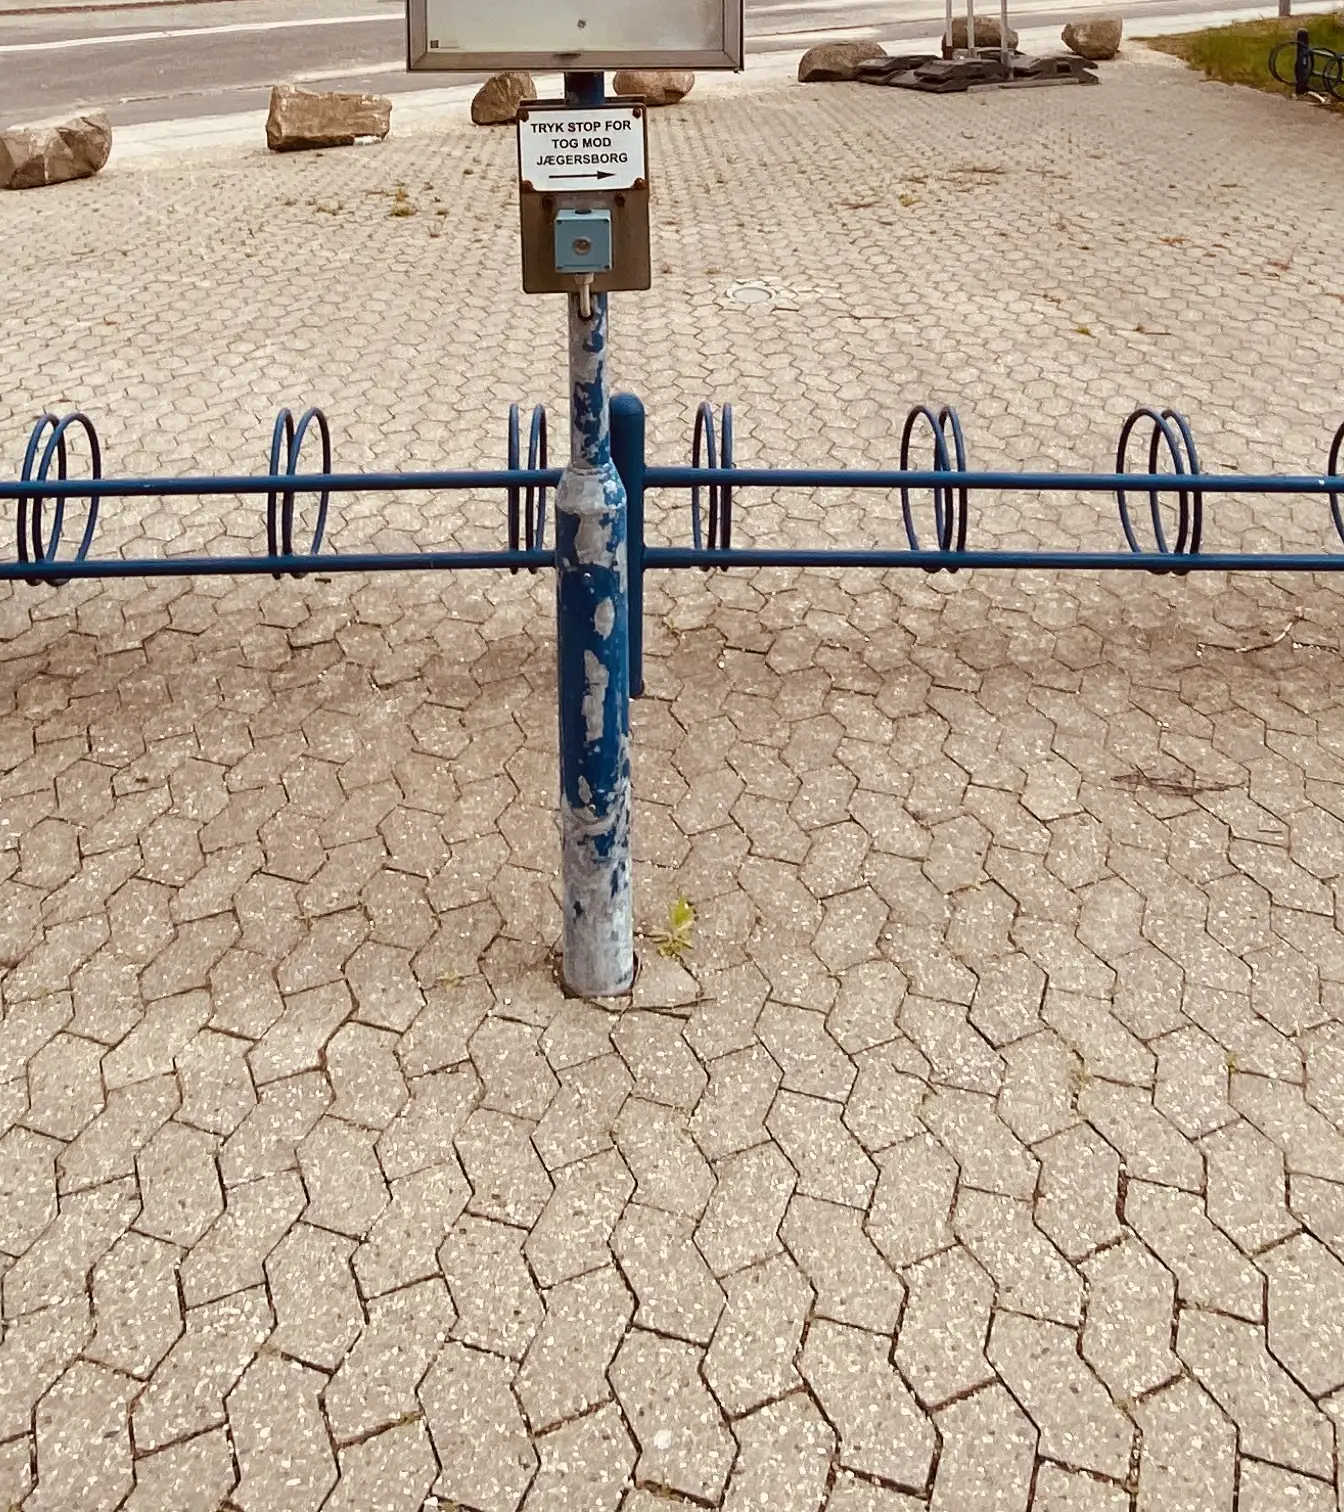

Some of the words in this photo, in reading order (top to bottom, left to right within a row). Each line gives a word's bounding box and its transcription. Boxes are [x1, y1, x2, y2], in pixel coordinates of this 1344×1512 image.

[530, 122, 565, 134] TRYK
[567, 121, 601, 133] STOP
[604, 120, 632, 132] FOR
[551, 138, 579, 149] TOG
[582, 137, 612, 148] MOD
[535, 152, 628, 166] JÆGERSBORG
